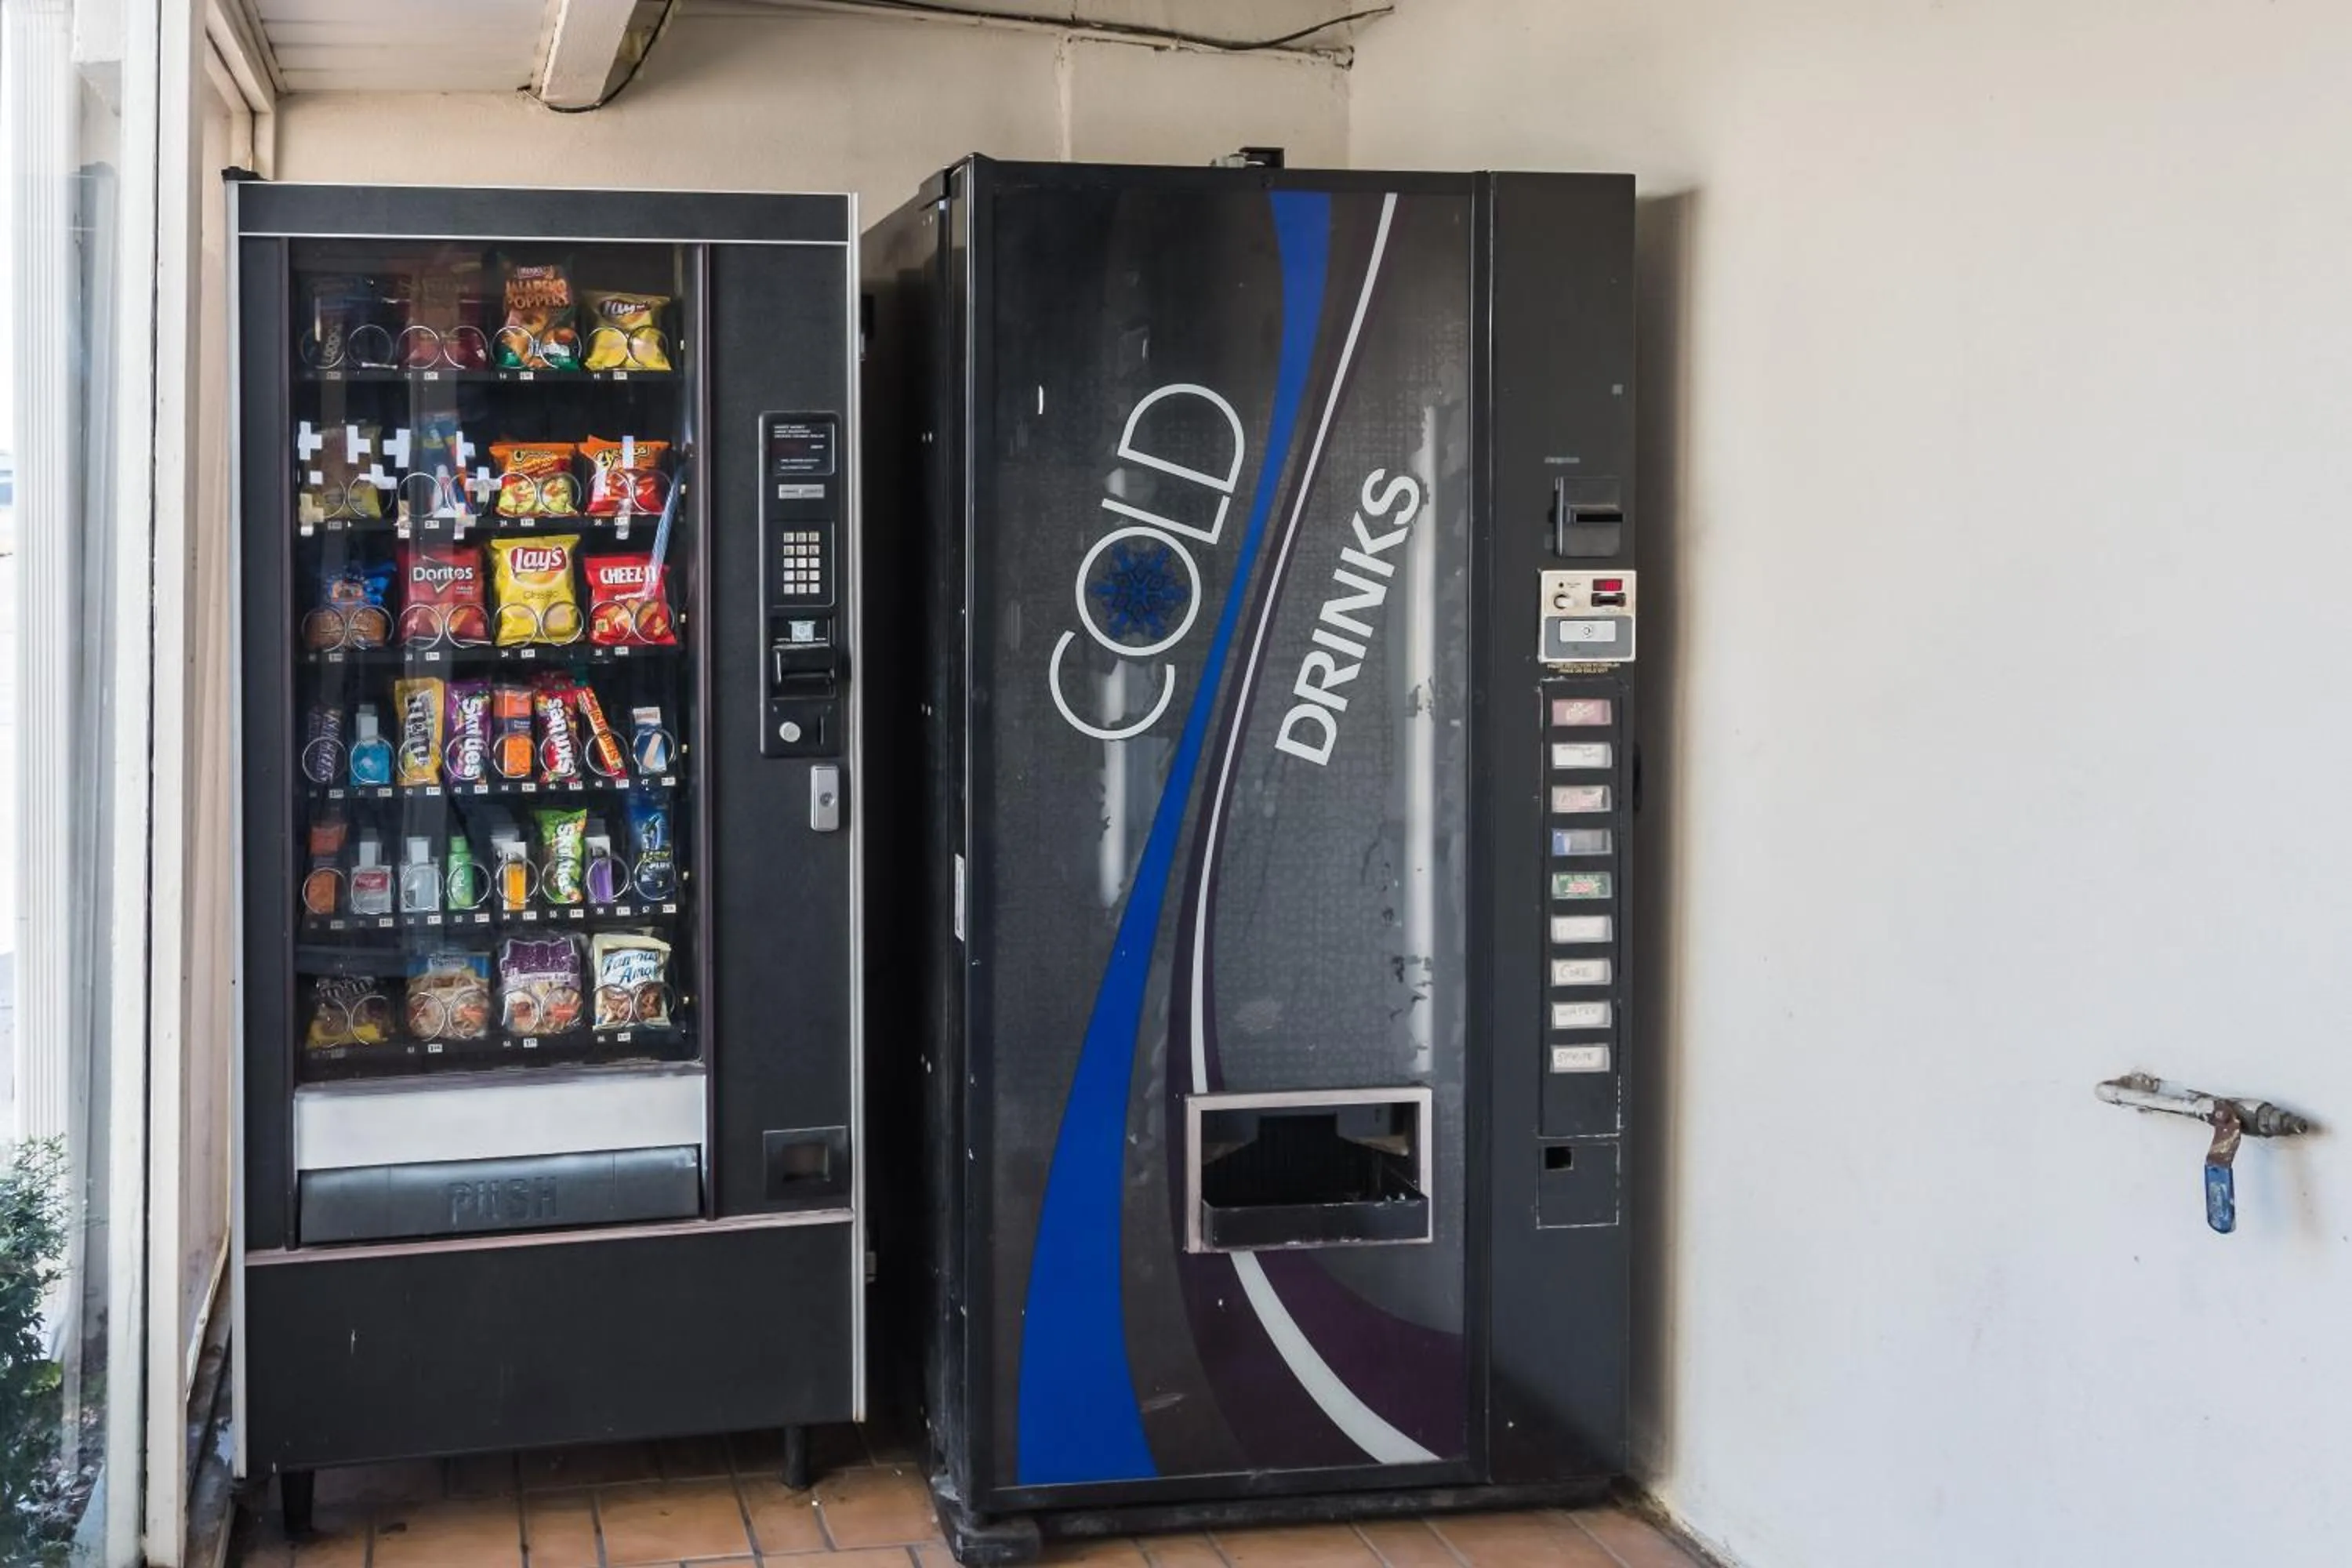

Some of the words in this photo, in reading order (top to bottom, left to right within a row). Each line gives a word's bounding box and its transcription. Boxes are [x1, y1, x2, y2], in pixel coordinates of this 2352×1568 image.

[412, 566, 474, 582] Doritos
[515, 545, 562, 572] Lay's
[1050, 383, 1245, 741] COLD
[1275, 468, 1421, 766] DRINKS
[448, 1176, 558, 1225] PUSH
